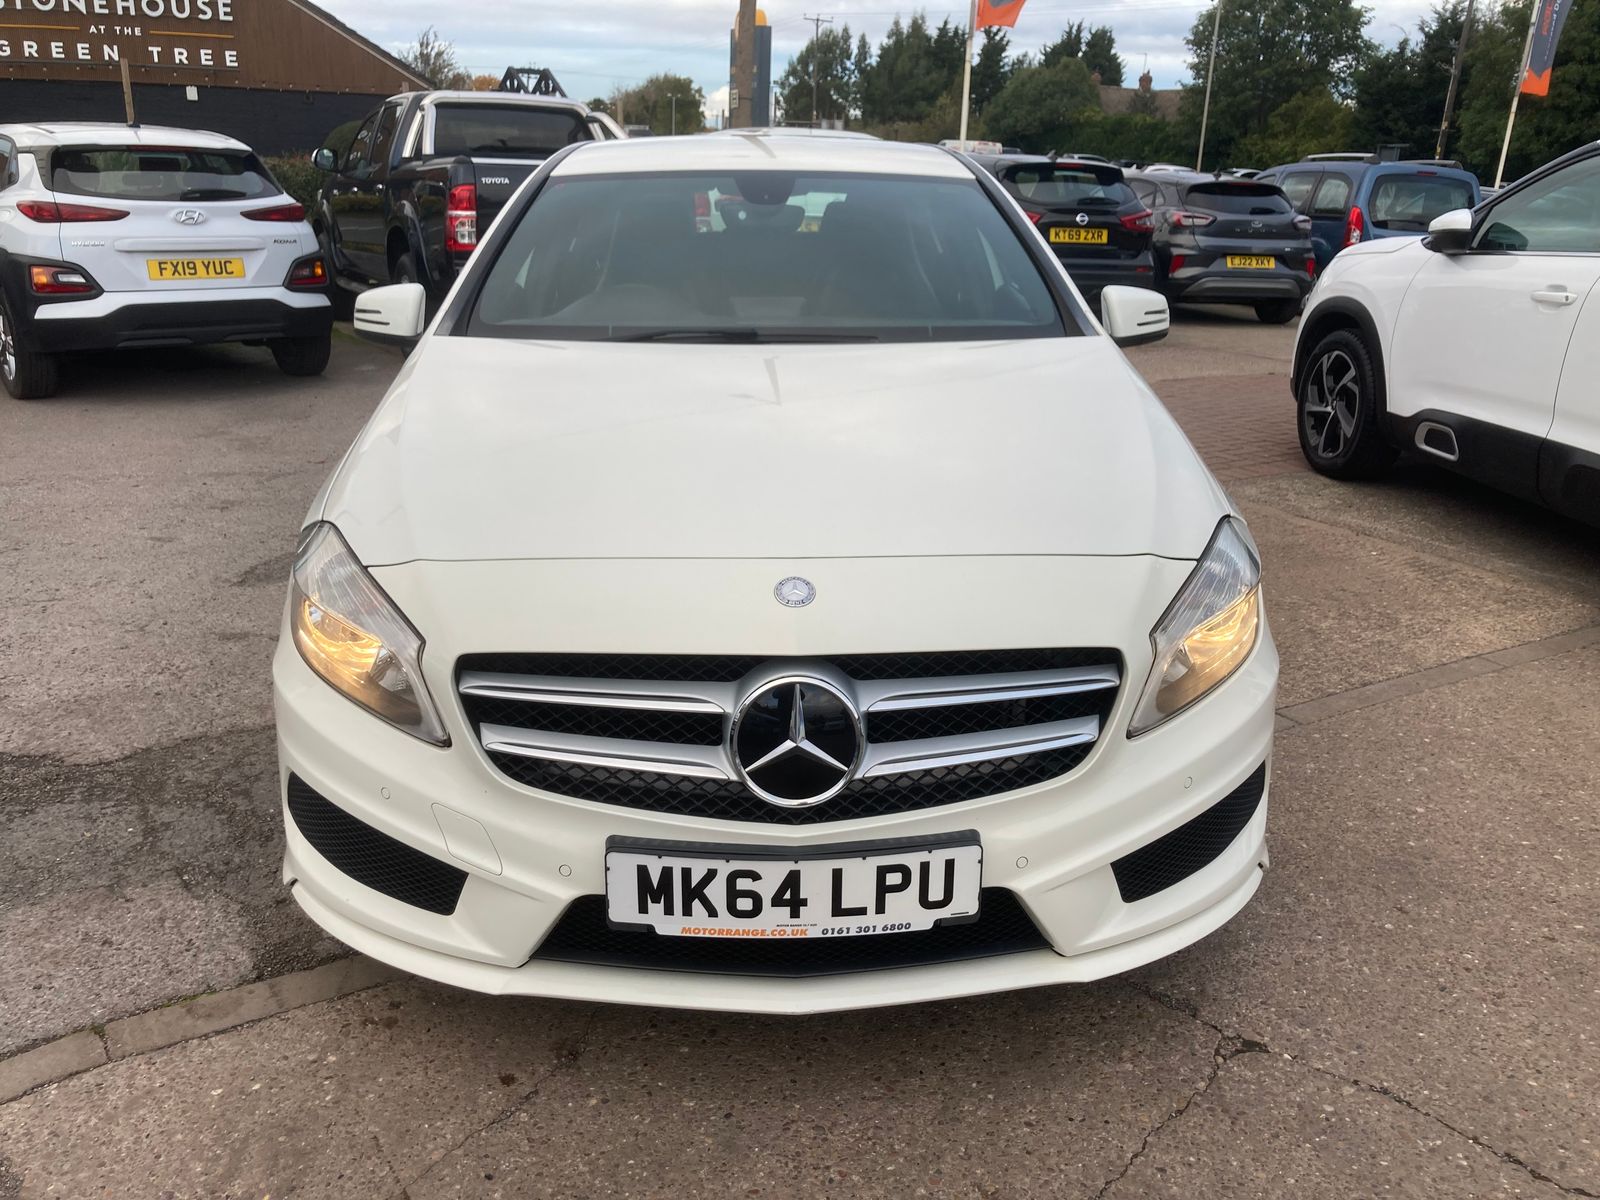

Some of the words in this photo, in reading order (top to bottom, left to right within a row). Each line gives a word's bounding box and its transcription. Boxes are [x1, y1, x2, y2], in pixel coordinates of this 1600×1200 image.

[89, 25, 106, 34] AT
[114, 26, 142, 36] THE
[0, 40, 119, 61] GREEN
[148, 46, 239, 67] TREE
[481, 177, 510, 185] TOYOTA
[1083, 229, 1104, 242] ZXR
[158, 261, 198, 277] FX19
[201, 260, 234, 276] YUC
[1230, 256, 1253, 267] EJ22
[636, 863, 808, 919] MK64
[831, 857, 956, 918] LPU
[681, 926, 808, 937] MOTORRANGE.CO.UK
[821, 926, 851, 936] 0161
[855, 925, 877, 934] 301
[881, 922, 912, 932] 6800
